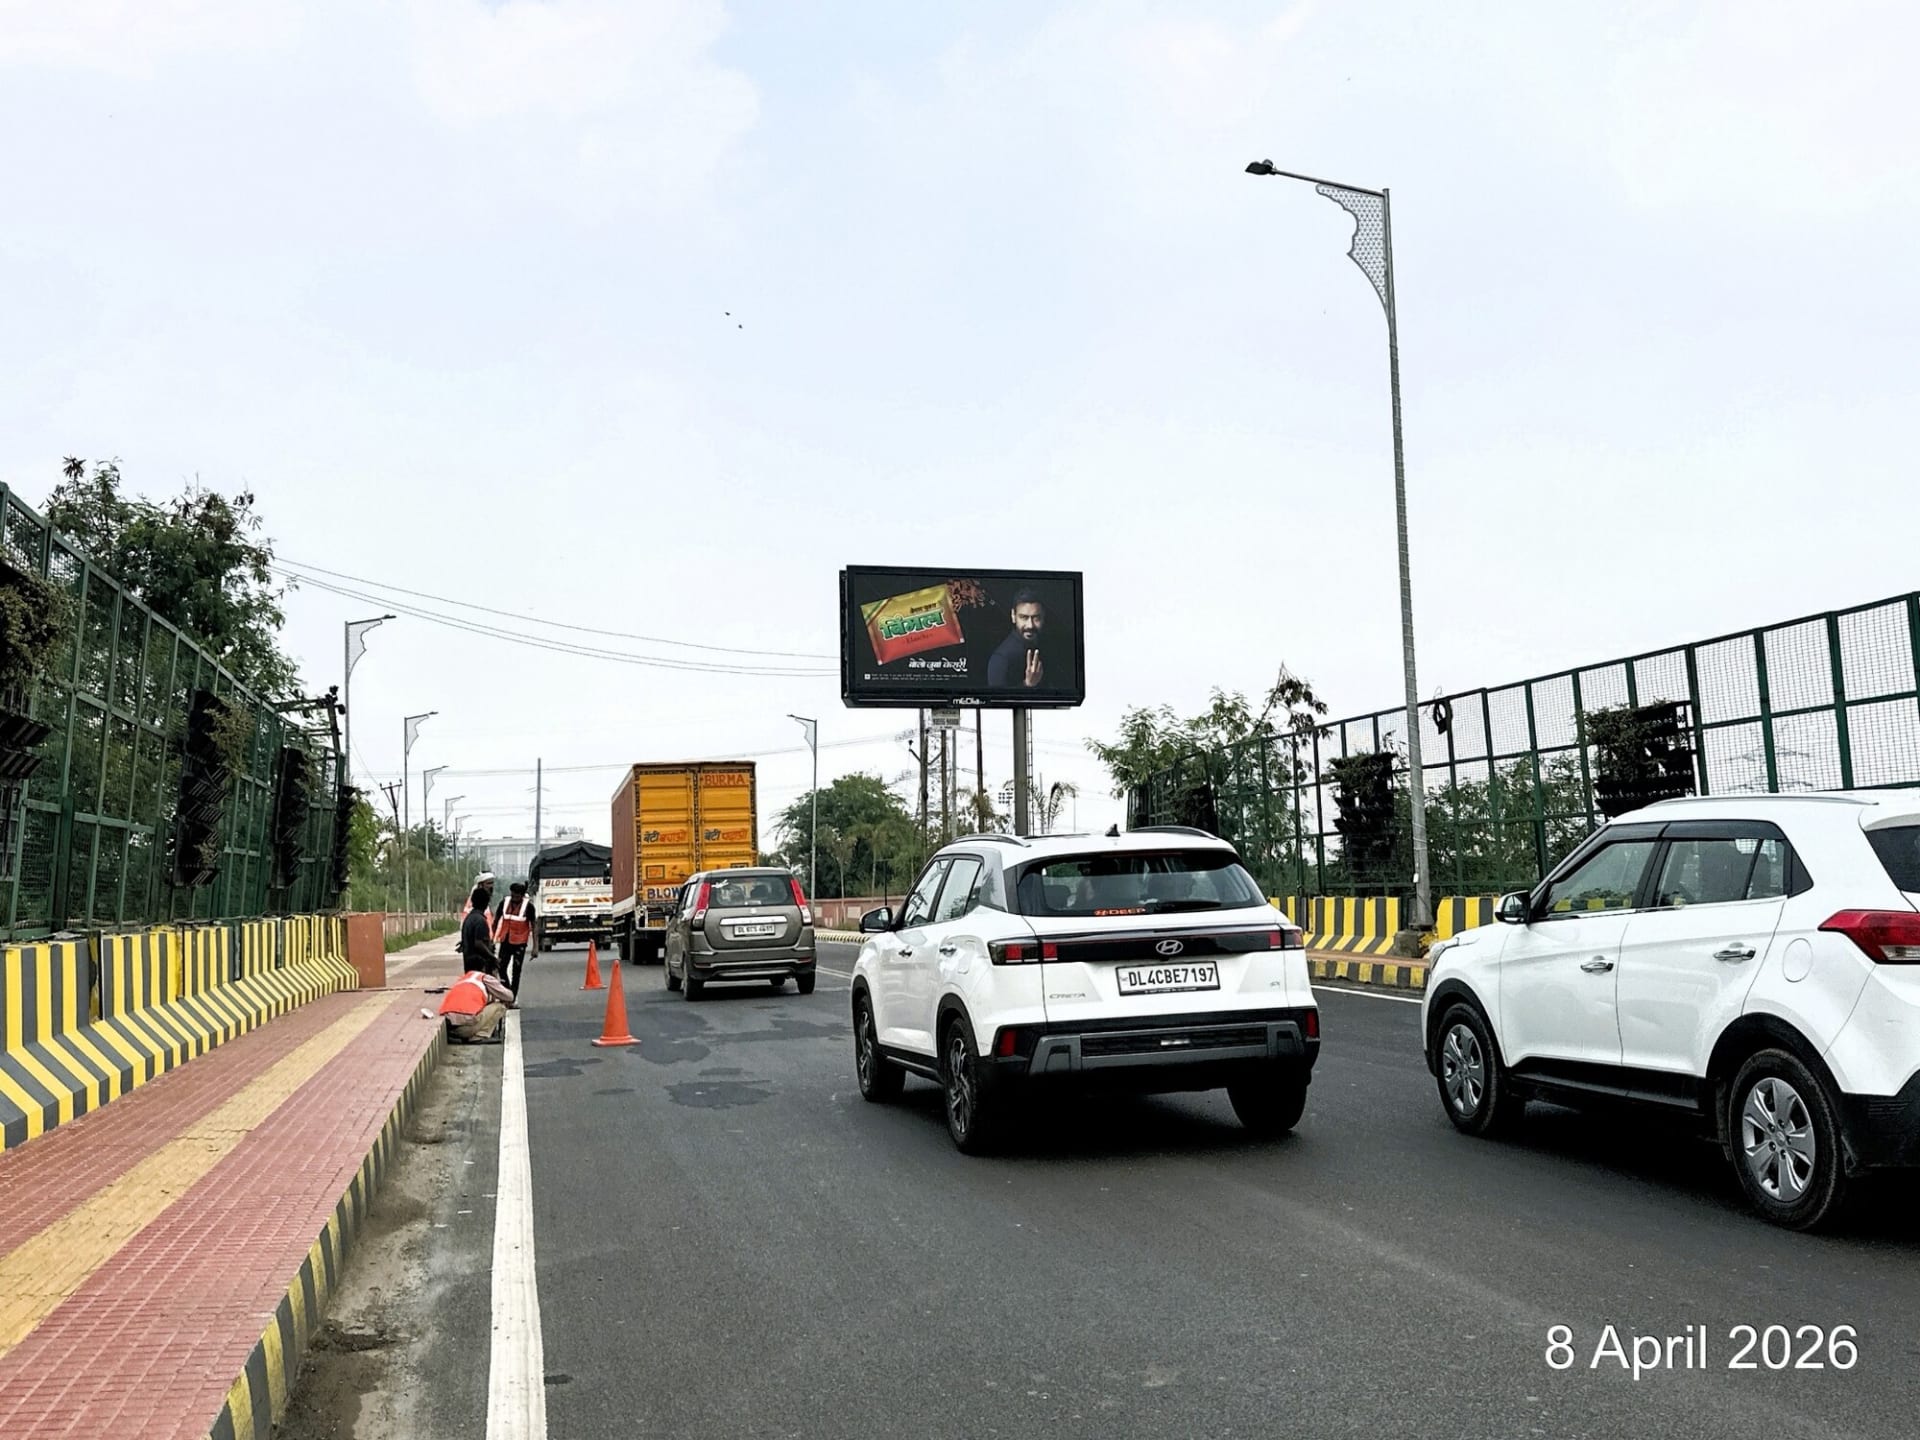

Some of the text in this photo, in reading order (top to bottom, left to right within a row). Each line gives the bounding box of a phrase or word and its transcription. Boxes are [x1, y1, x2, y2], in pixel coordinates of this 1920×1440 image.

[545, 878, 604, 887] BLOW HOR
[1128, 967, 1214, 987] DL4CBE7197
